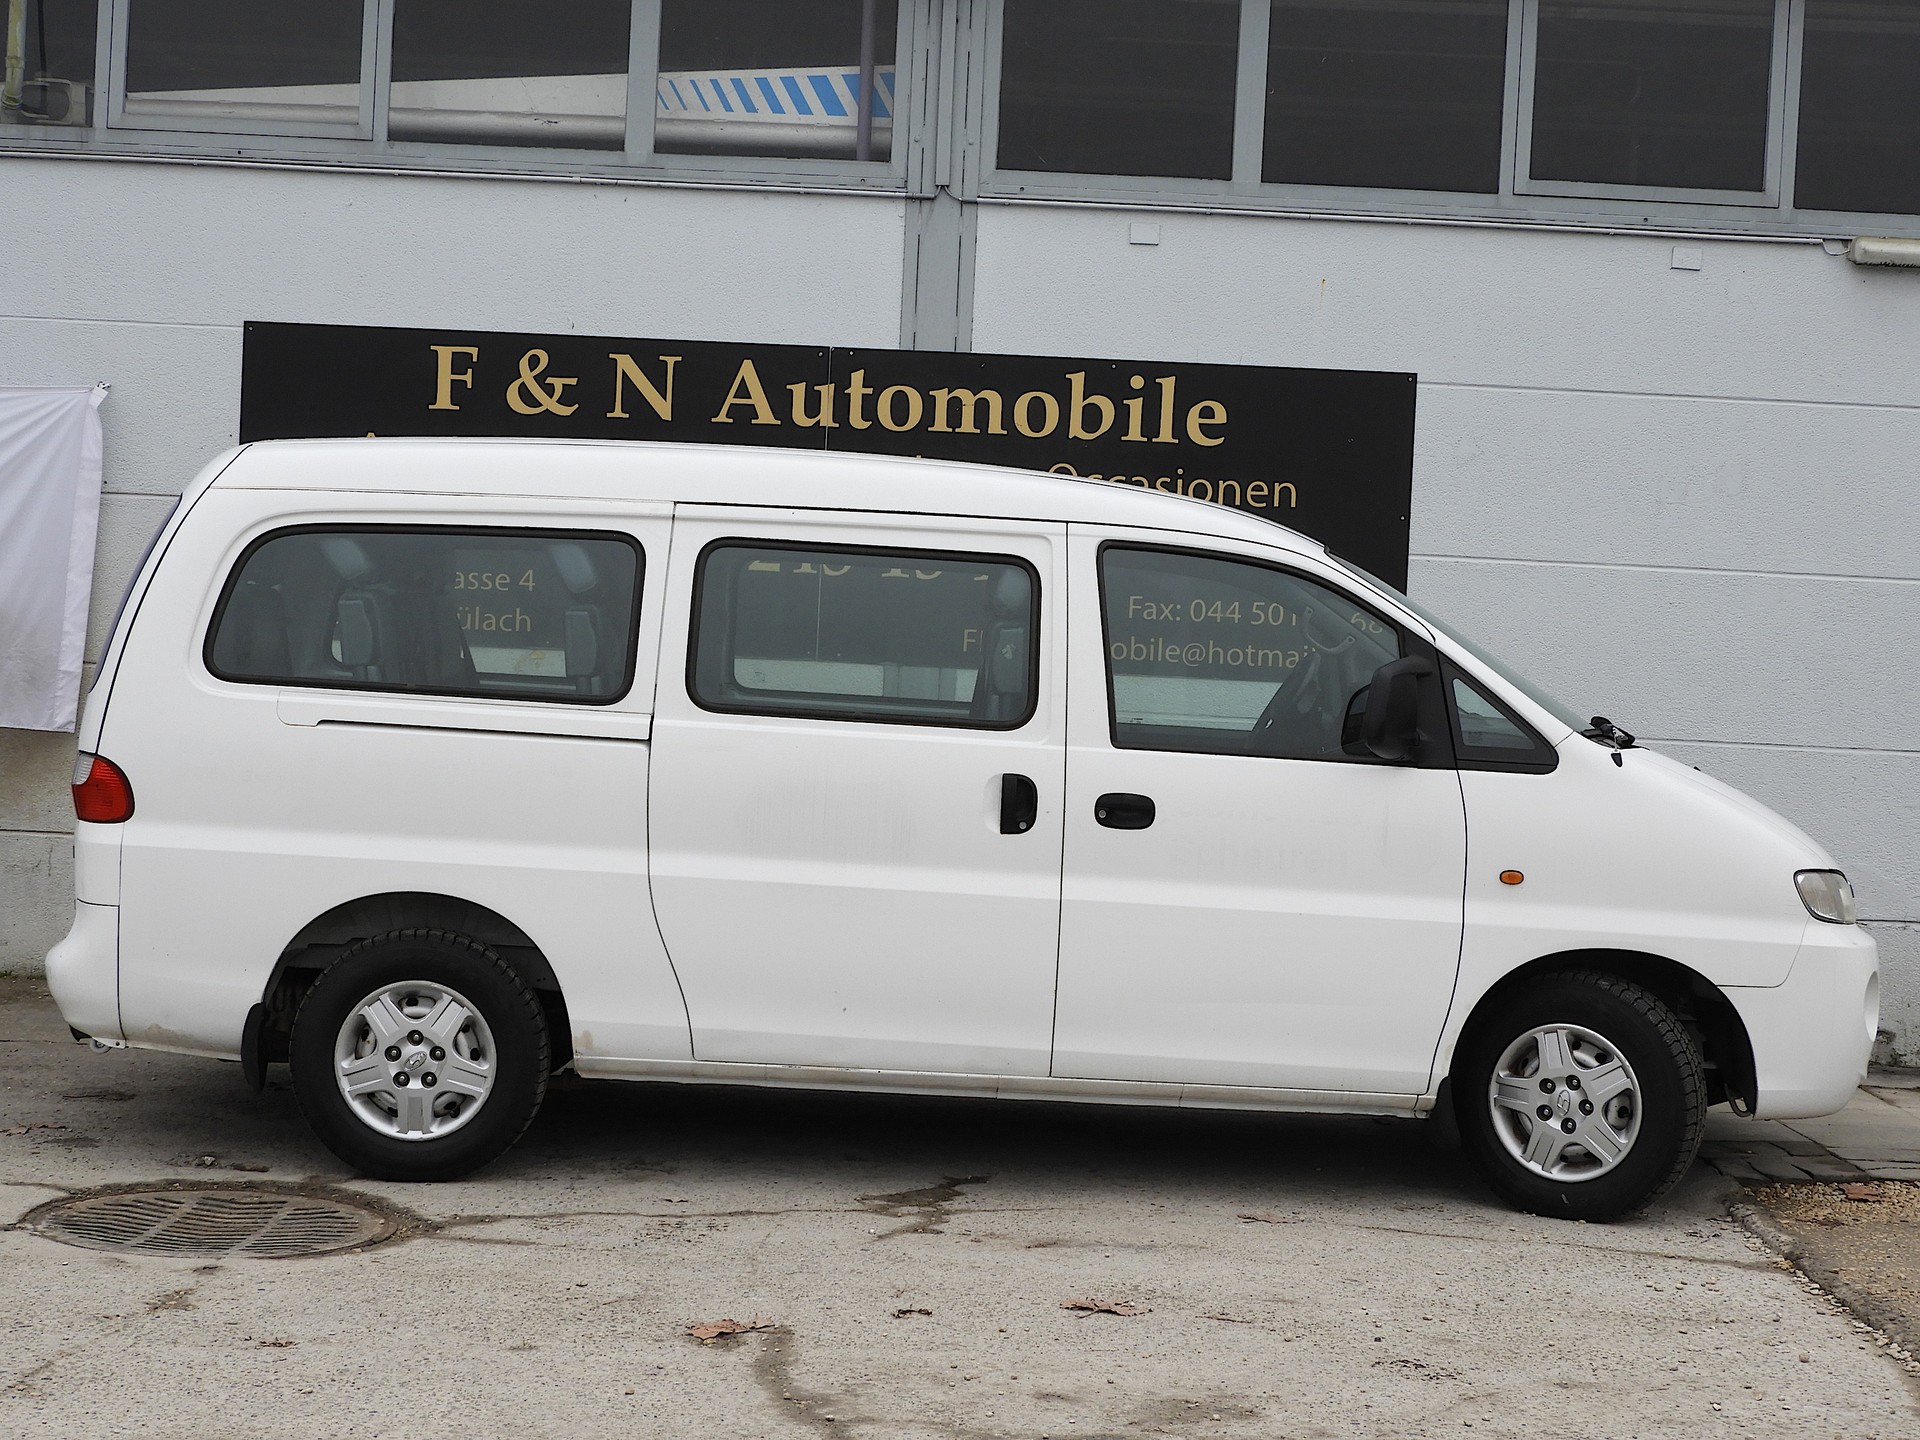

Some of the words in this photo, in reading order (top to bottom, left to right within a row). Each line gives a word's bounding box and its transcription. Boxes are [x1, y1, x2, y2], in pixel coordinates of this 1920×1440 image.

[428, 345, 479, 410] F
[506, 348, 579, 416] &
[606, 353, 682, 421] N
[711, 358, 1228, 447] Automobile
[1048, 462, 1297, 508] sionen
[518, 569, 536, 592] 4
[1128, 595, 1181, 621] Fax:
[1190, 599, 1242, 624] 044
[1111, 635, 1316, 668] obile@hotma
